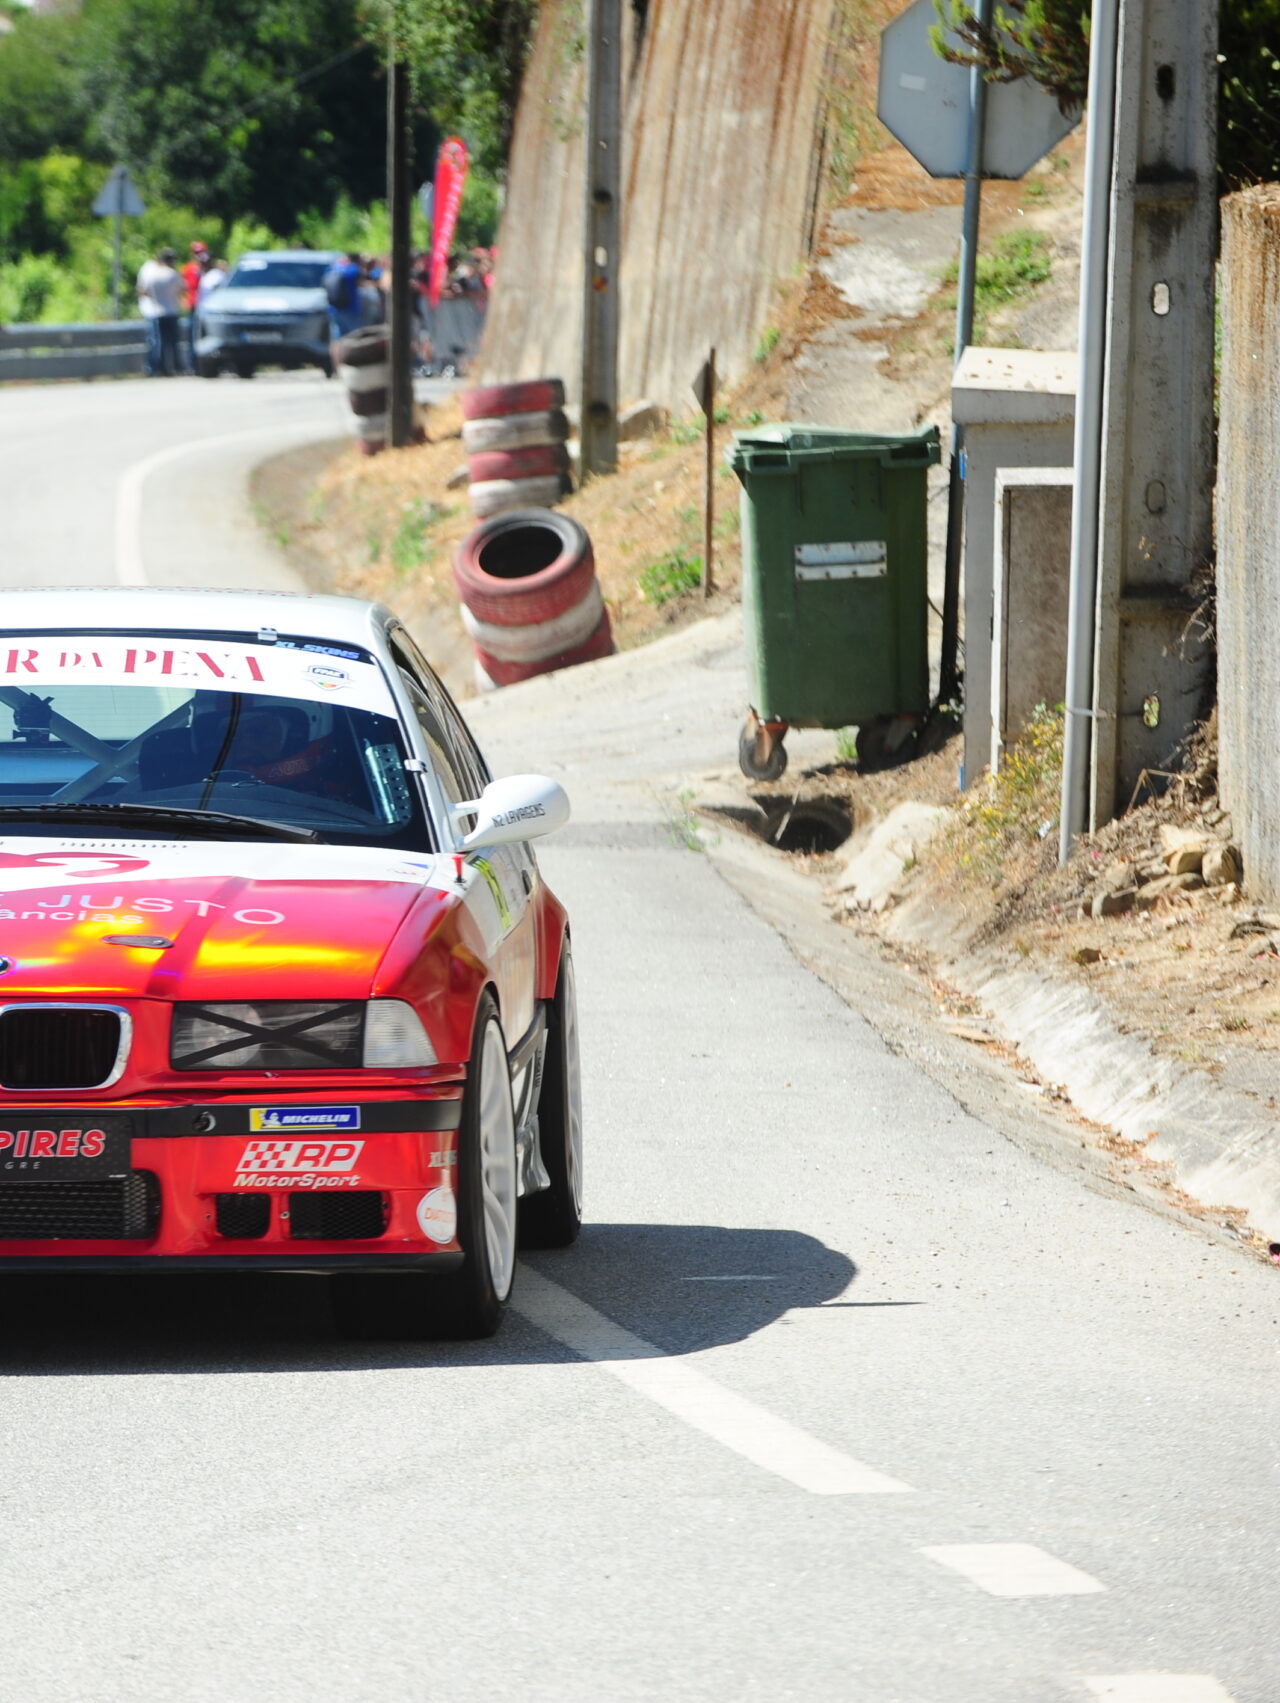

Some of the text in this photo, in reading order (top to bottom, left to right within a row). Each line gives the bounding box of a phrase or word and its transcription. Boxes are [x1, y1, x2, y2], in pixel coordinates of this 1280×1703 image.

[58, 652, 104, 668] DA
[124, 649, 266, 682] PENA
[37, 894, 286, 926] JUSTO
[282, 1114, 351, 1125] MICHELIN
[293, 1143, 357, 1168] RP
[233, 1173, 362, 1190] MotorSport
